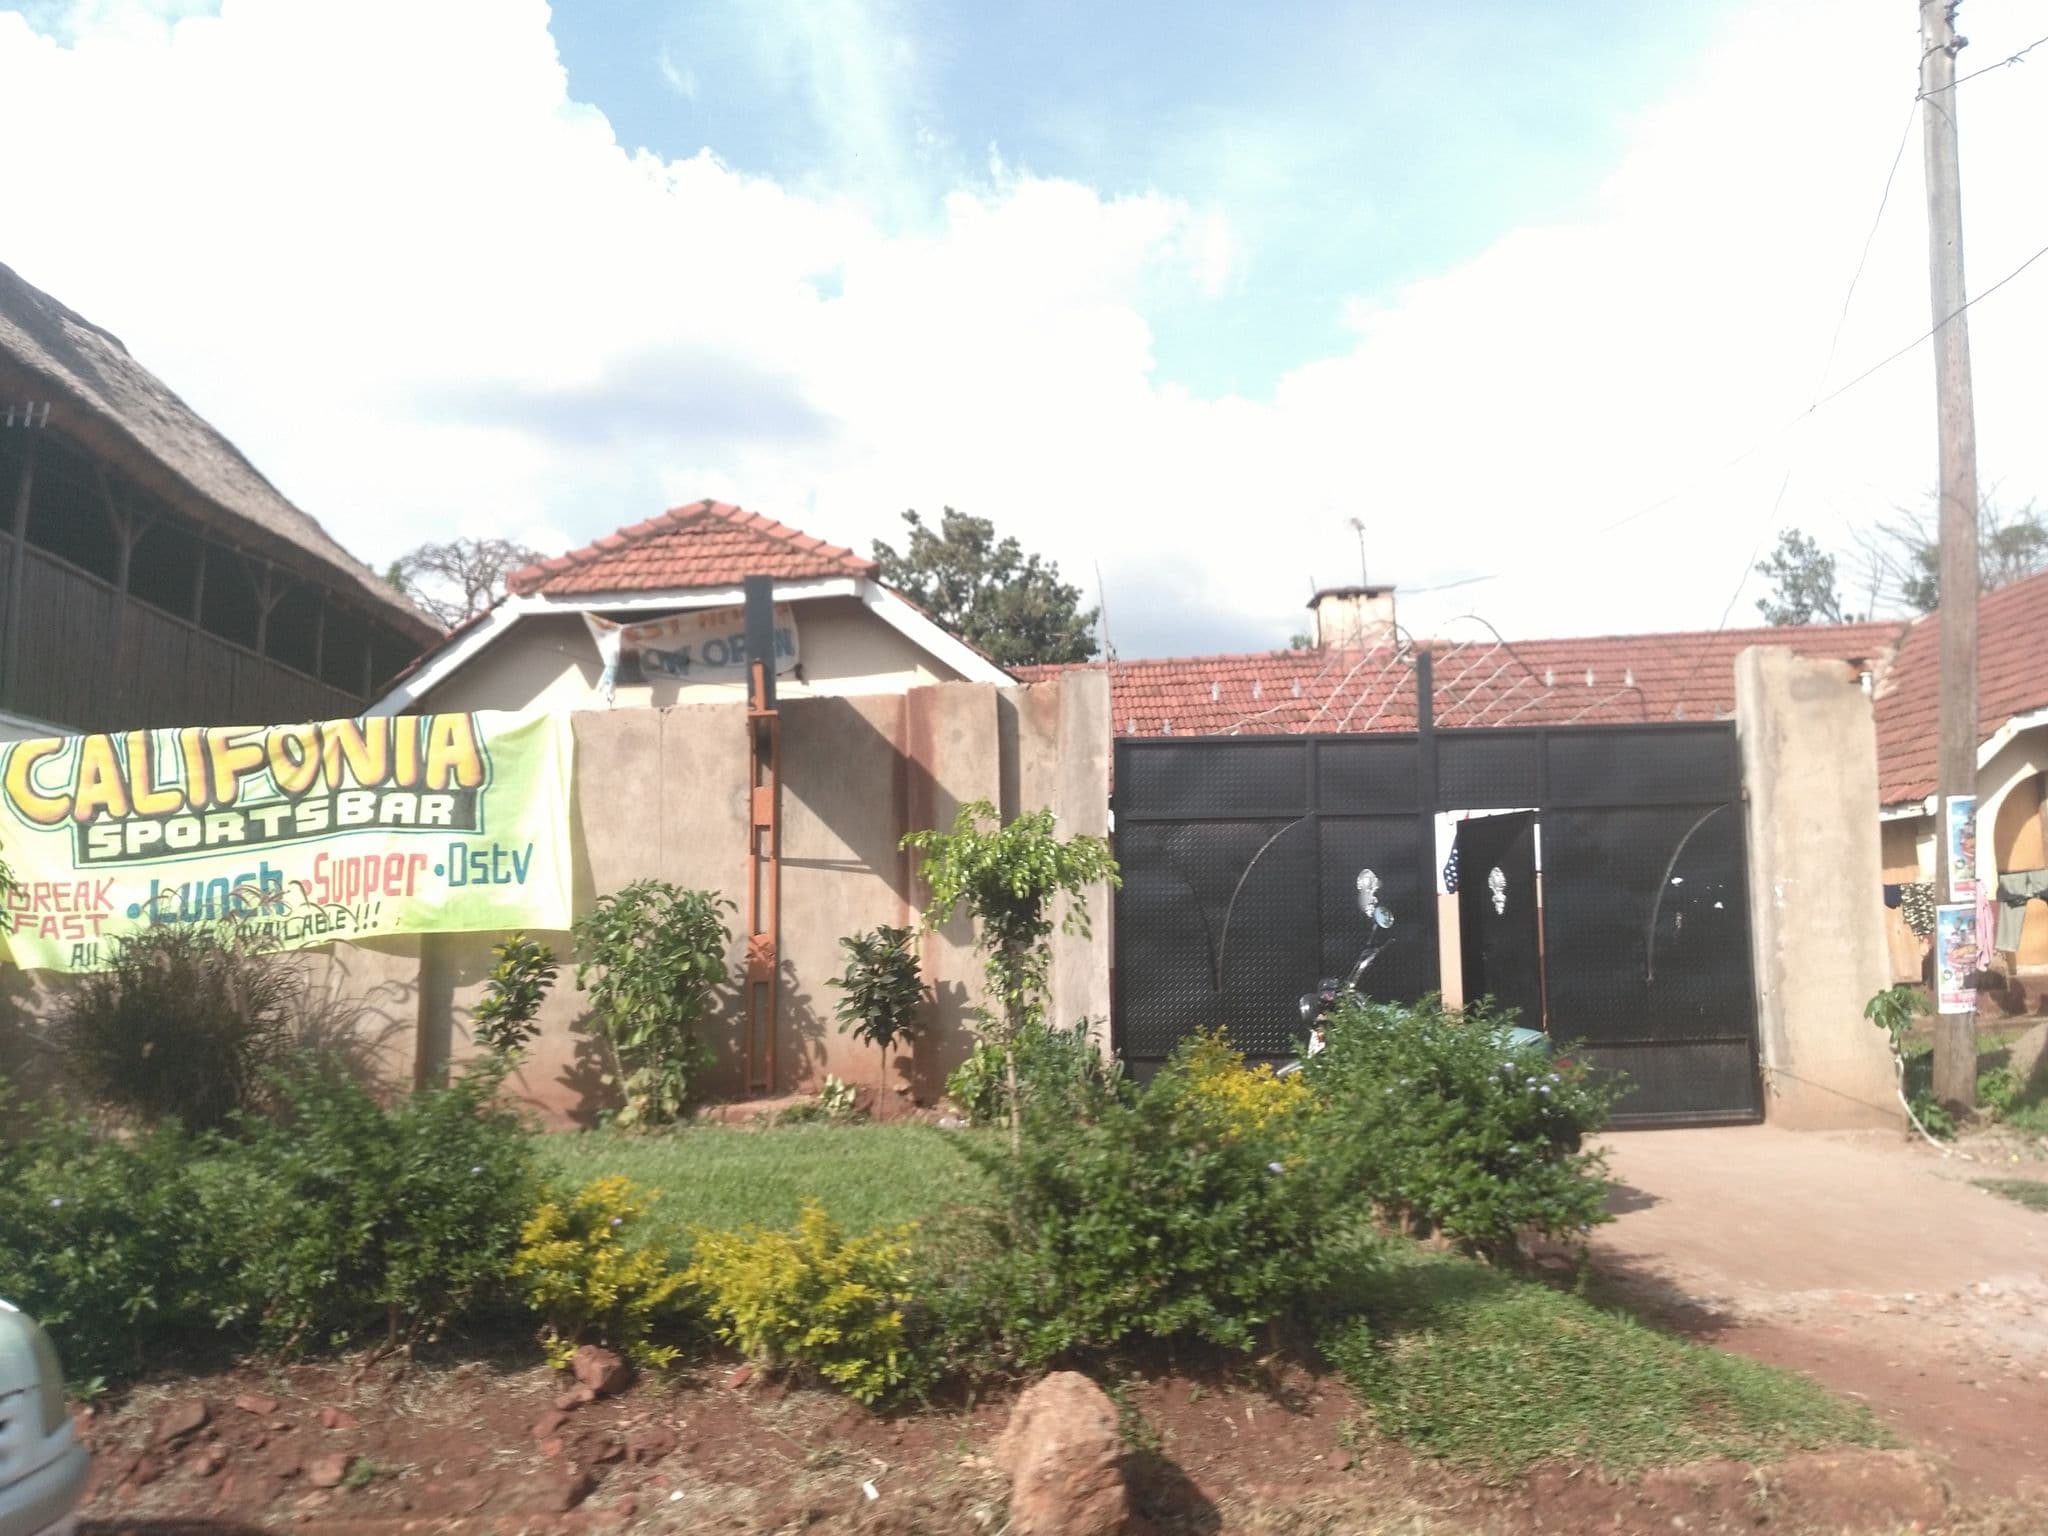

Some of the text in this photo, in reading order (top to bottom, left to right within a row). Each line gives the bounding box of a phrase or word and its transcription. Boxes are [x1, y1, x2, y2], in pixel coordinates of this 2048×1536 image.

[702, 628, 796, 668] OPN
[4, 712, 485, 825] CALIFONIA
[8, 877, 115, 912] BREAK
[150, 861, 285, 924] Lunch
[314, 852, 428, 905] Supper
[12, 913, 108, 940] FAST
